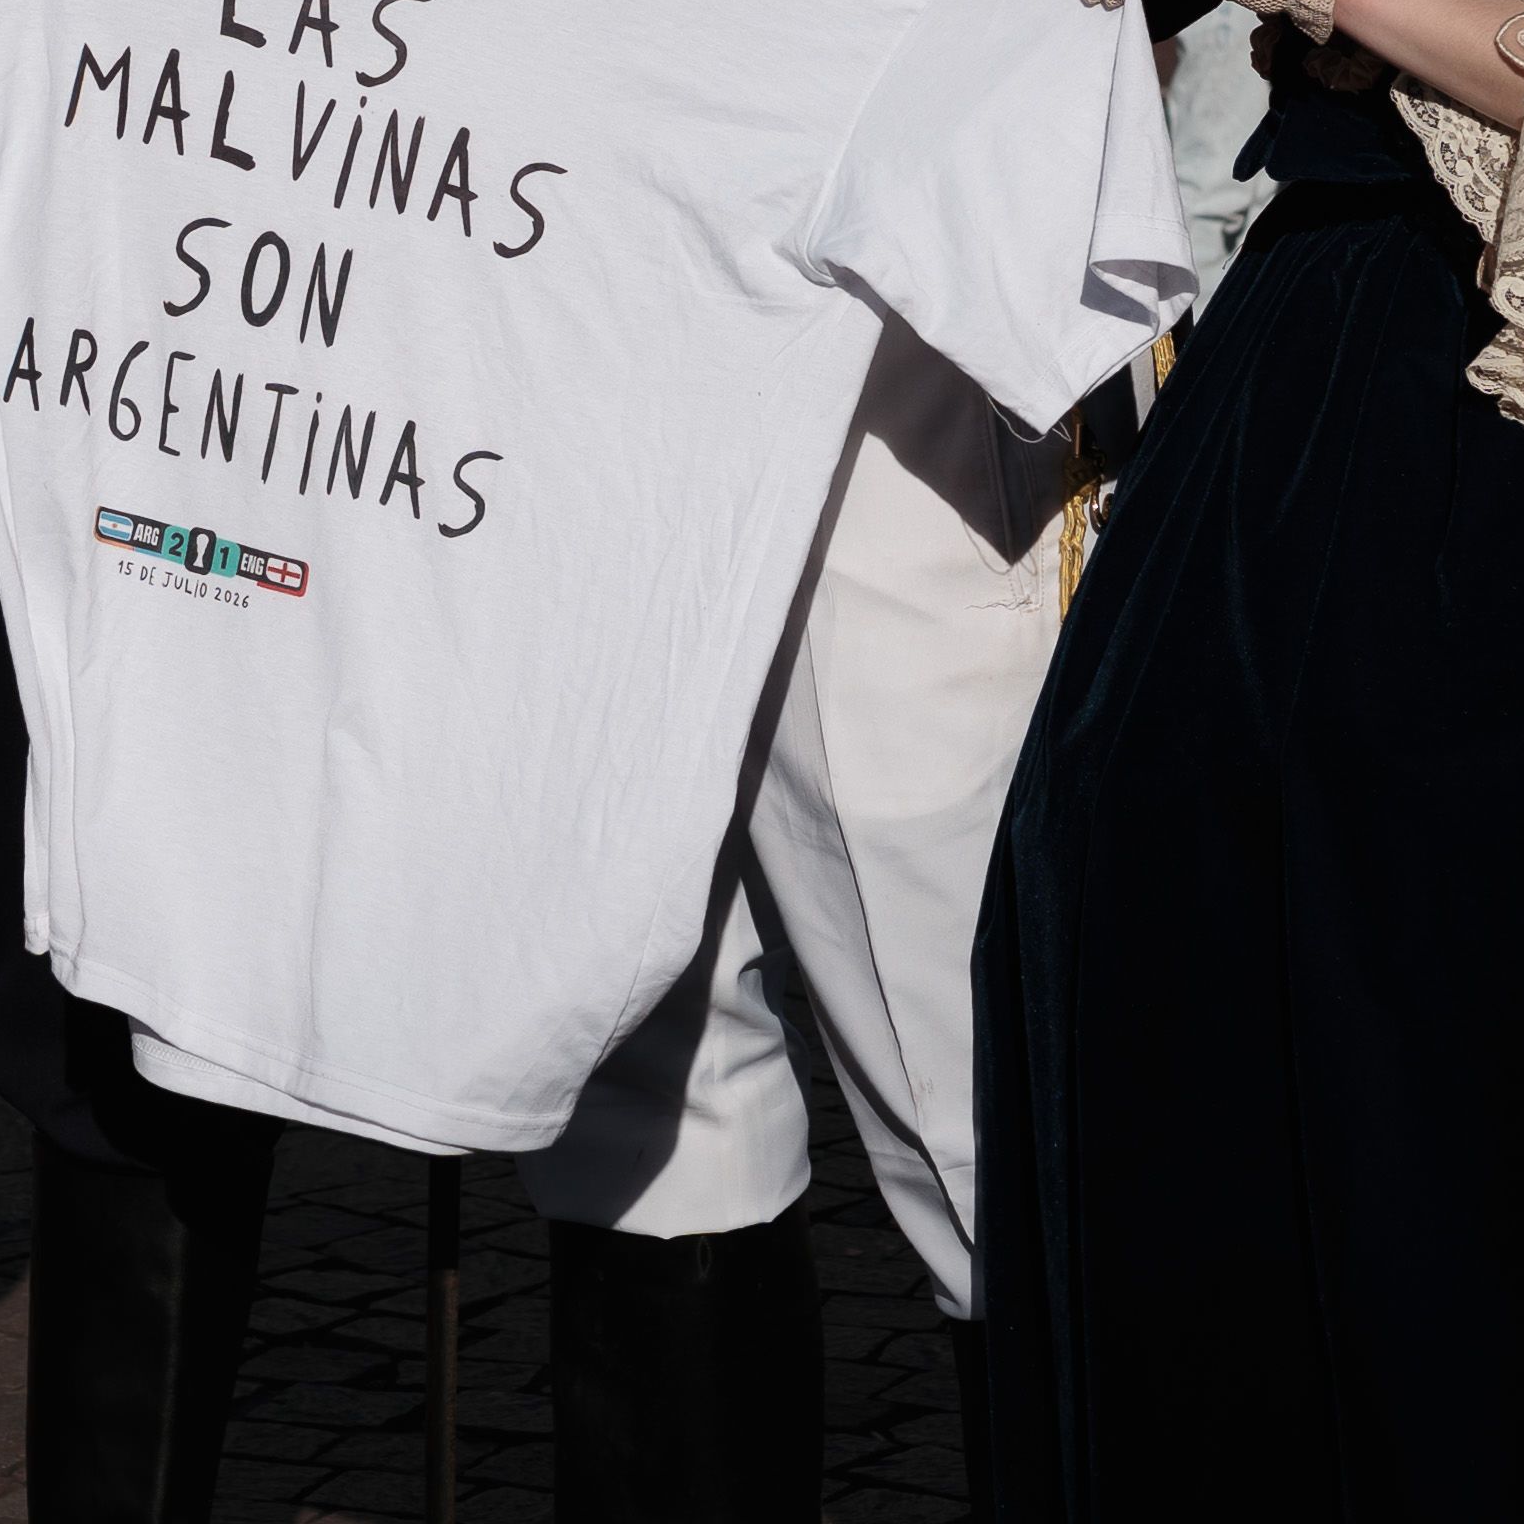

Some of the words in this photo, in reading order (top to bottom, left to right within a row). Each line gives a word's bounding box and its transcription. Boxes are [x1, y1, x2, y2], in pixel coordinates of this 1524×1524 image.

[163, 218, 353, 348] SON
[133, 523, 160, 546] ARG
[168, 532, 185, 558] 2
[219, 546, 231, 570] 1
[240, 552, 265, 576] ENG
[118, 560, 133, 576] 15
[140, 565, 156, 586] DE
[162, 571, 208, 598] JULIO
[214, 586, 250, 609] 2026
